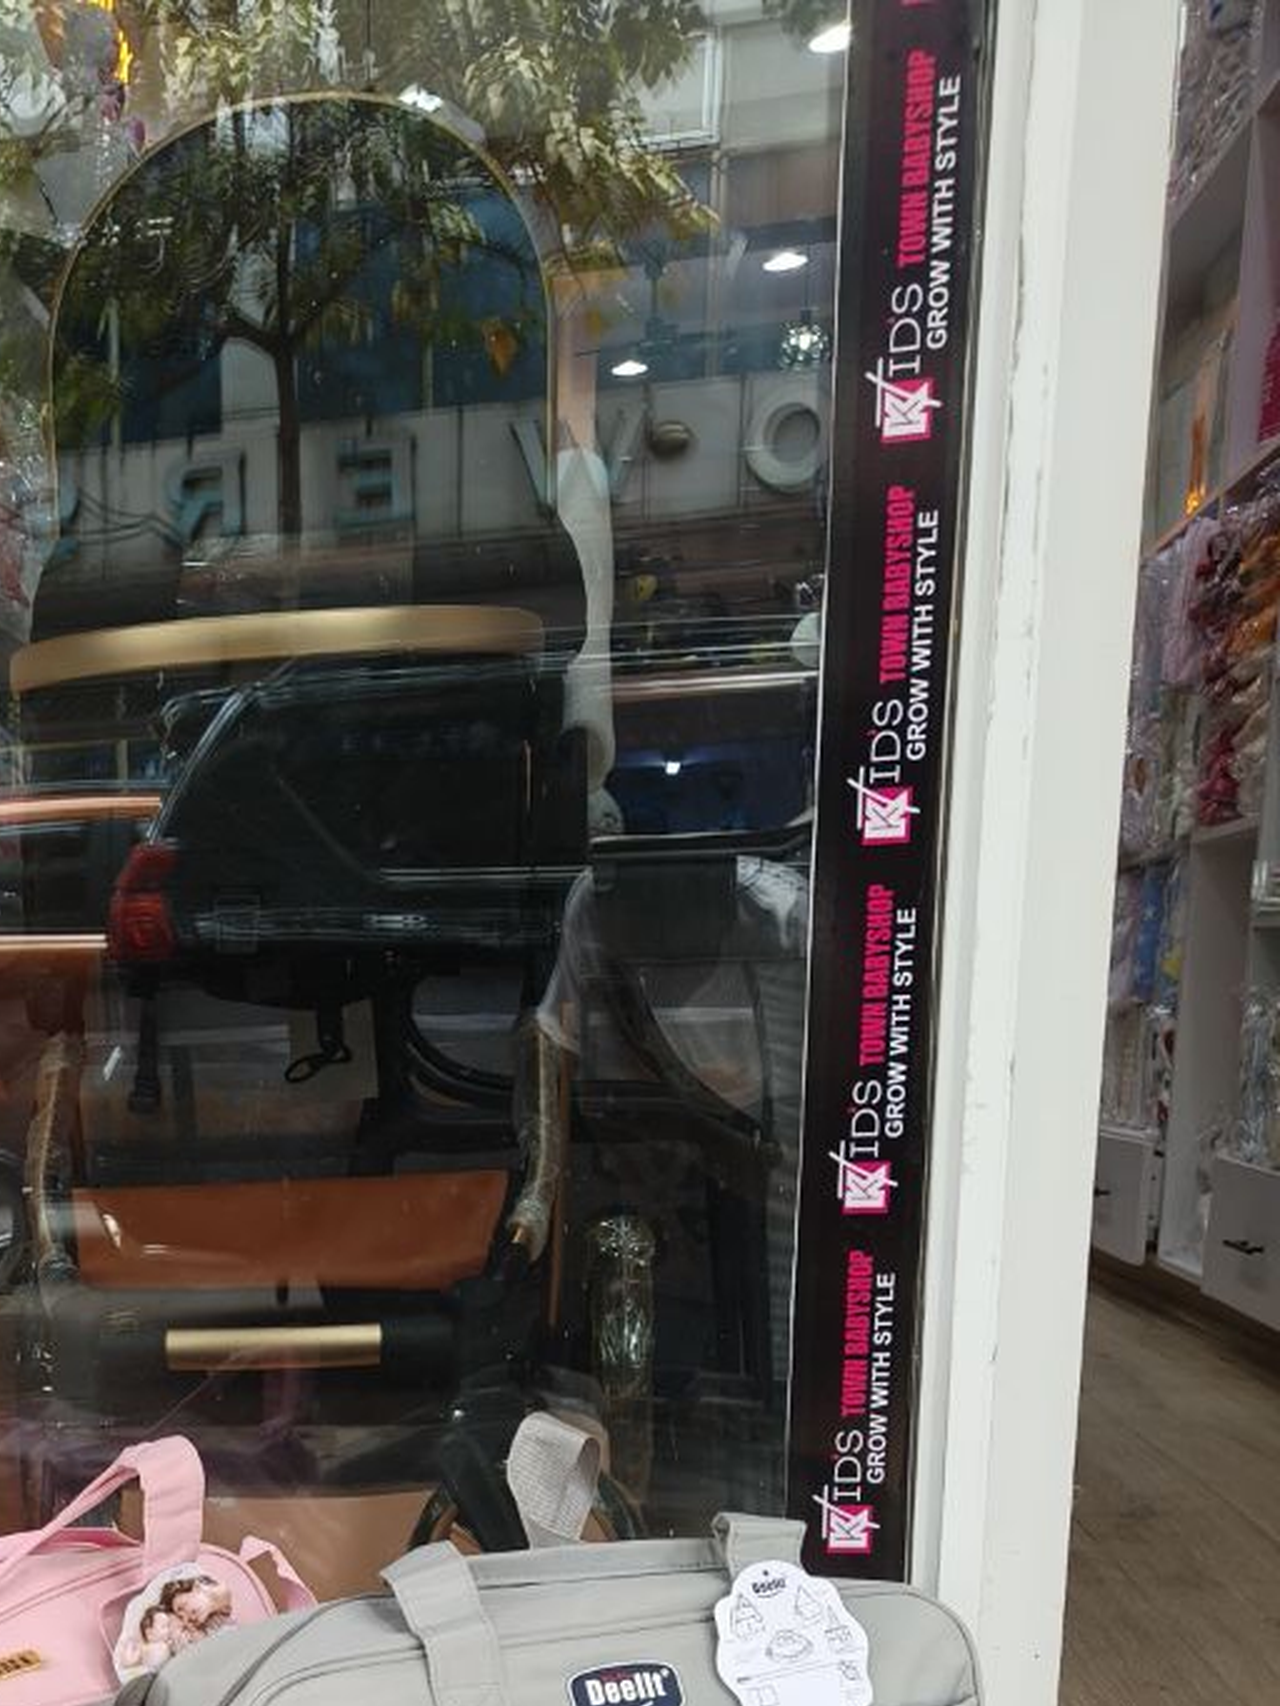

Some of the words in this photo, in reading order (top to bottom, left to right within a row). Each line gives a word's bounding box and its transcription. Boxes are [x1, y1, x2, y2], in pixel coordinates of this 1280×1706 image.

[902, 49, 936, 187] BABYSHOP
[934, 74, 961, 171] STYLE
[897, 191, 928, 268] TOWN
[931, 177, 955, 252] WITH
[926, 260, 951, 349] GROW
[882, 484, 915, 611] BABYSHOP
[915, 509, 939, 596] STYLE
[879, 615, 910, 685] TOWN
[912, 604, 934, 673] WITH
[907, 677, 931, 761] GROW
[863, 884, 894, 1000] BABYSHOP
[893, 907, 916, 986] STYLE
[859, 1002, 887, 1066] TOWN
[889, 994, 911, 1056] WITH
[884, 1062, 908, 1138] GROW
[844, 1250, 874, 1355] BABYSHOP
[873, 1272, 896, 1345] STYLE
[841, 1359, 869, 1416] TOWN
[871, 1352, 892, 1408] WITH
[866, 1414, 889, 1484] GROW
